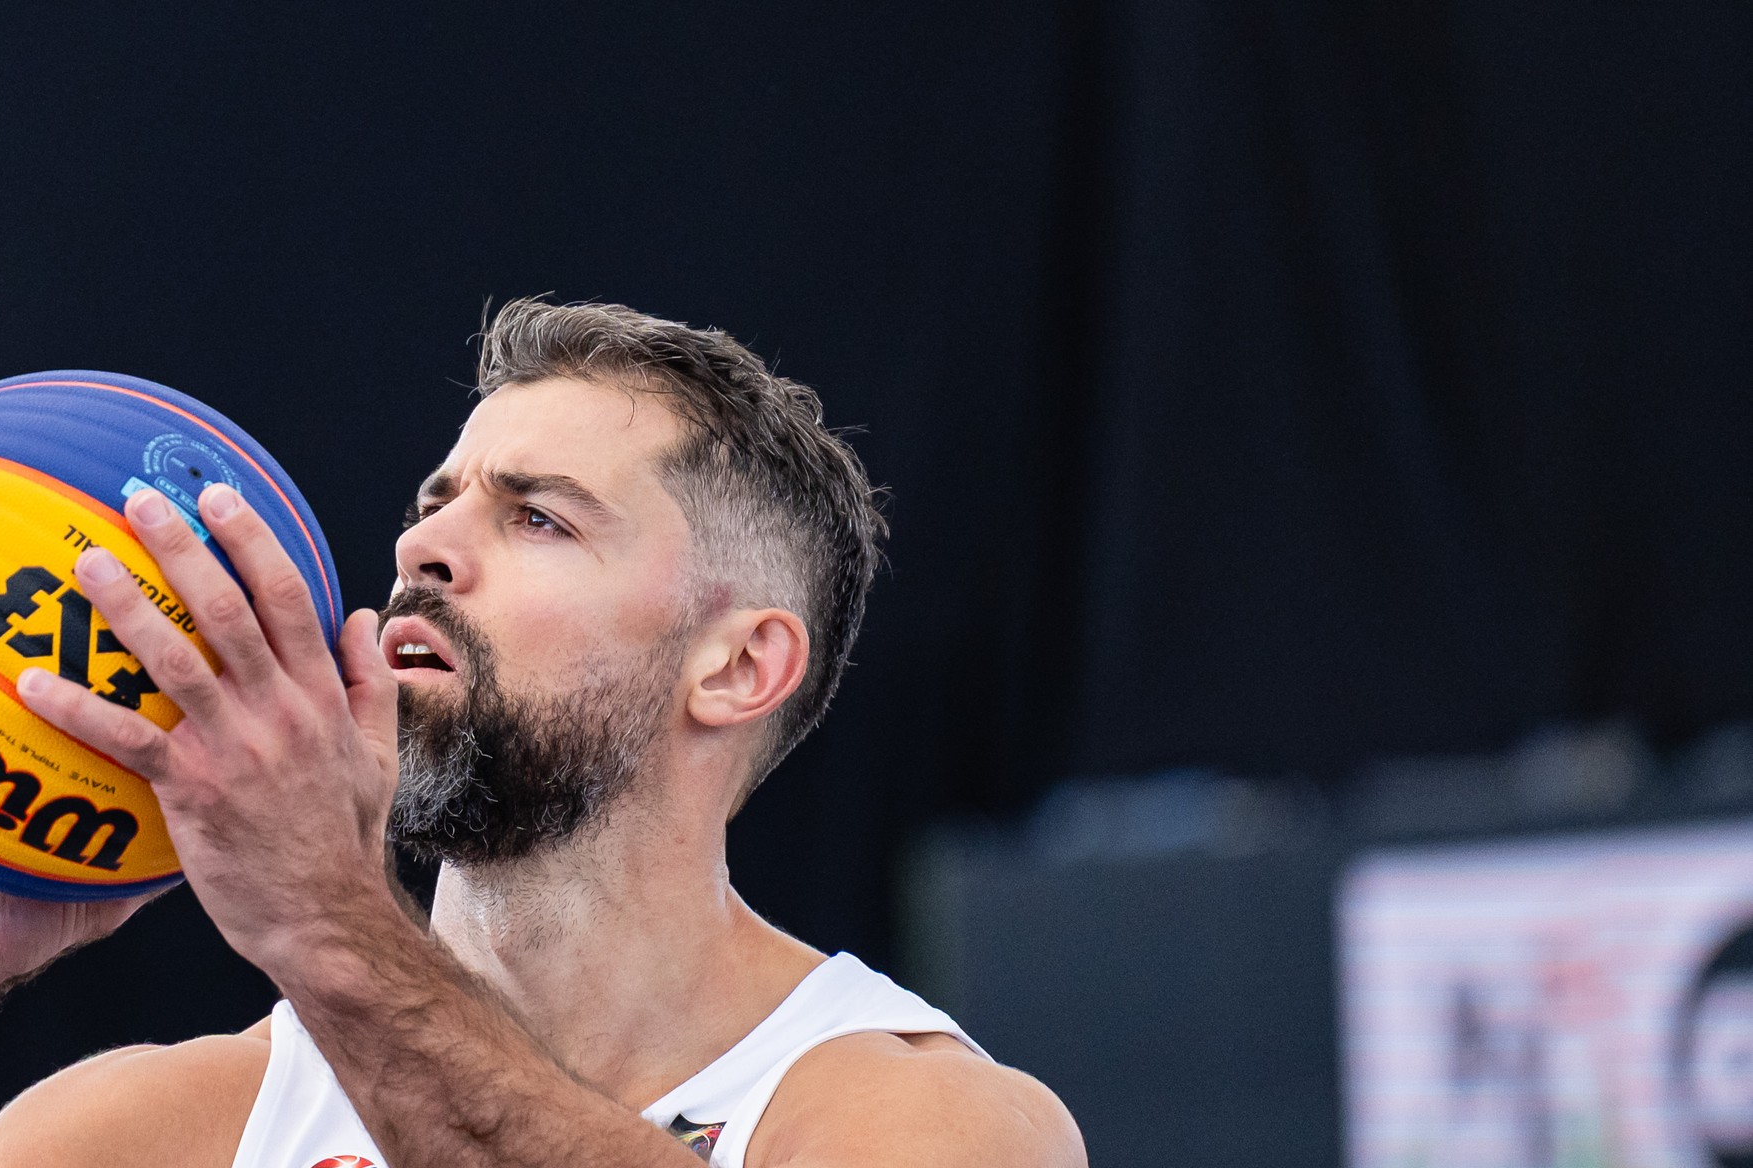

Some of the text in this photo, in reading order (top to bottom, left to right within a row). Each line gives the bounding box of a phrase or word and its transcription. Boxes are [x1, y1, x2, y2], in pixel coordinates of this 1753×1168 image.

[63, 524, 197, 634] OFFICI ALL
[20, 743, 61, 772] TRIPLE
[69, 770, 116, 794] WAVE
